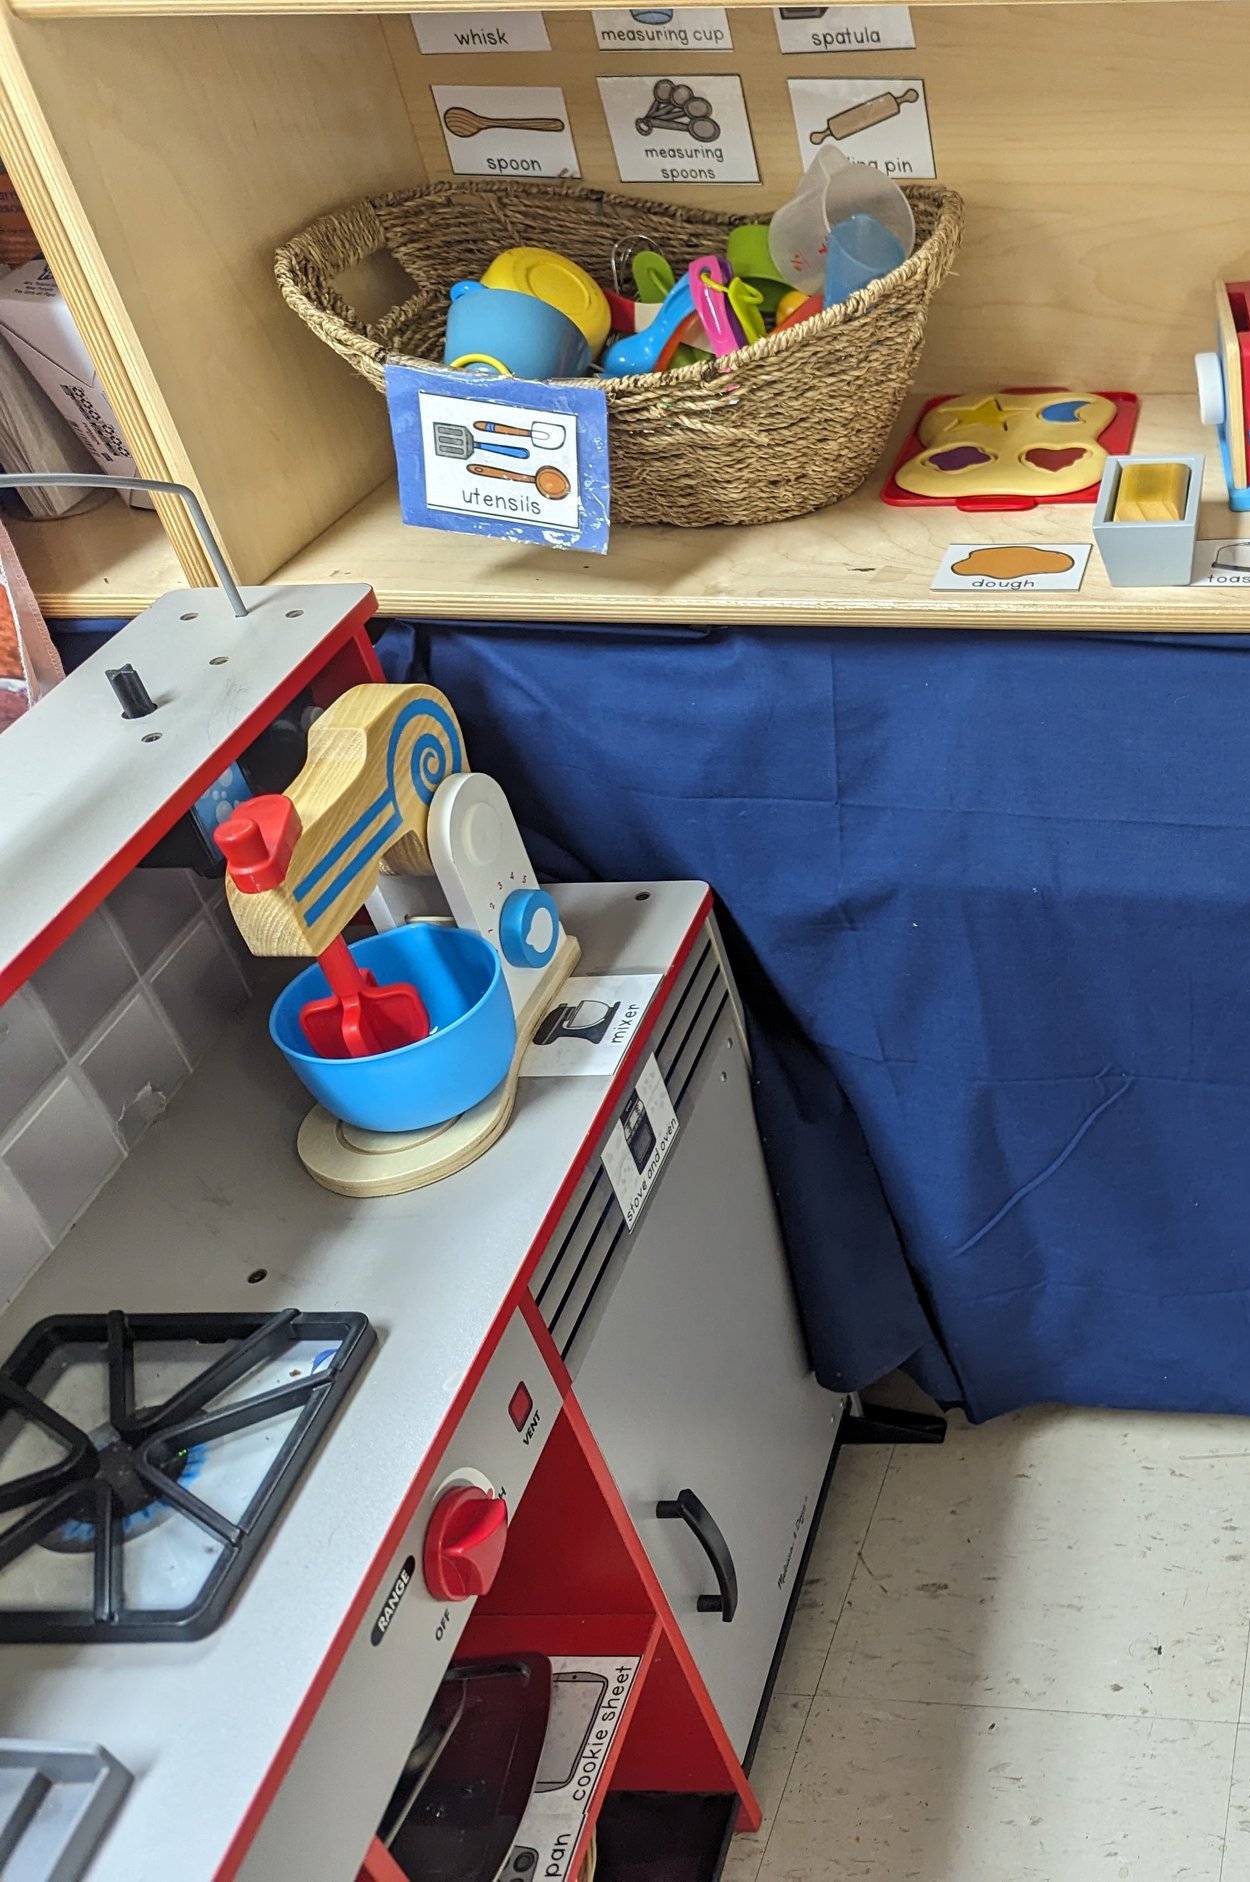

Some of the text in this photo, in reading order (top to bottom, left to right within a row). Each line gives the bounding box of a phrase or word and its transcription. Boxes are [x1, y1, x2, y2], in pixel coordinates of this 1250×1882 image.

[454, 28, 509, 46] whisk
[601, 26, 725, 46] measuring cup
[811, 27, 881, 47] spatula
[486, 157, 542, 174] spoon
[645, 145, 724, 163] measuring
[885, 157, 914, 176] pin
[661, 167, 716, 181] spoons
[462, 487, 542, 515] utensils
[972, 578, 1035, 591] dough
[489, 901, 496, 910] 2
[510, 871, 515, 880] 4
[522, 874, 528, 884] 5
[610, 1003, 640, 1044] mixer
[626, 1117, 678, 1222] stove and oven
[522, 1409, 541, 1446] VENT
[378, 1569, 410, 1632] RANGE
[435, 1608, 450, 1641] OFF
[573, 1665, 632, 1801] cookie sheet
[544, 1833, 571, 1877] pan
